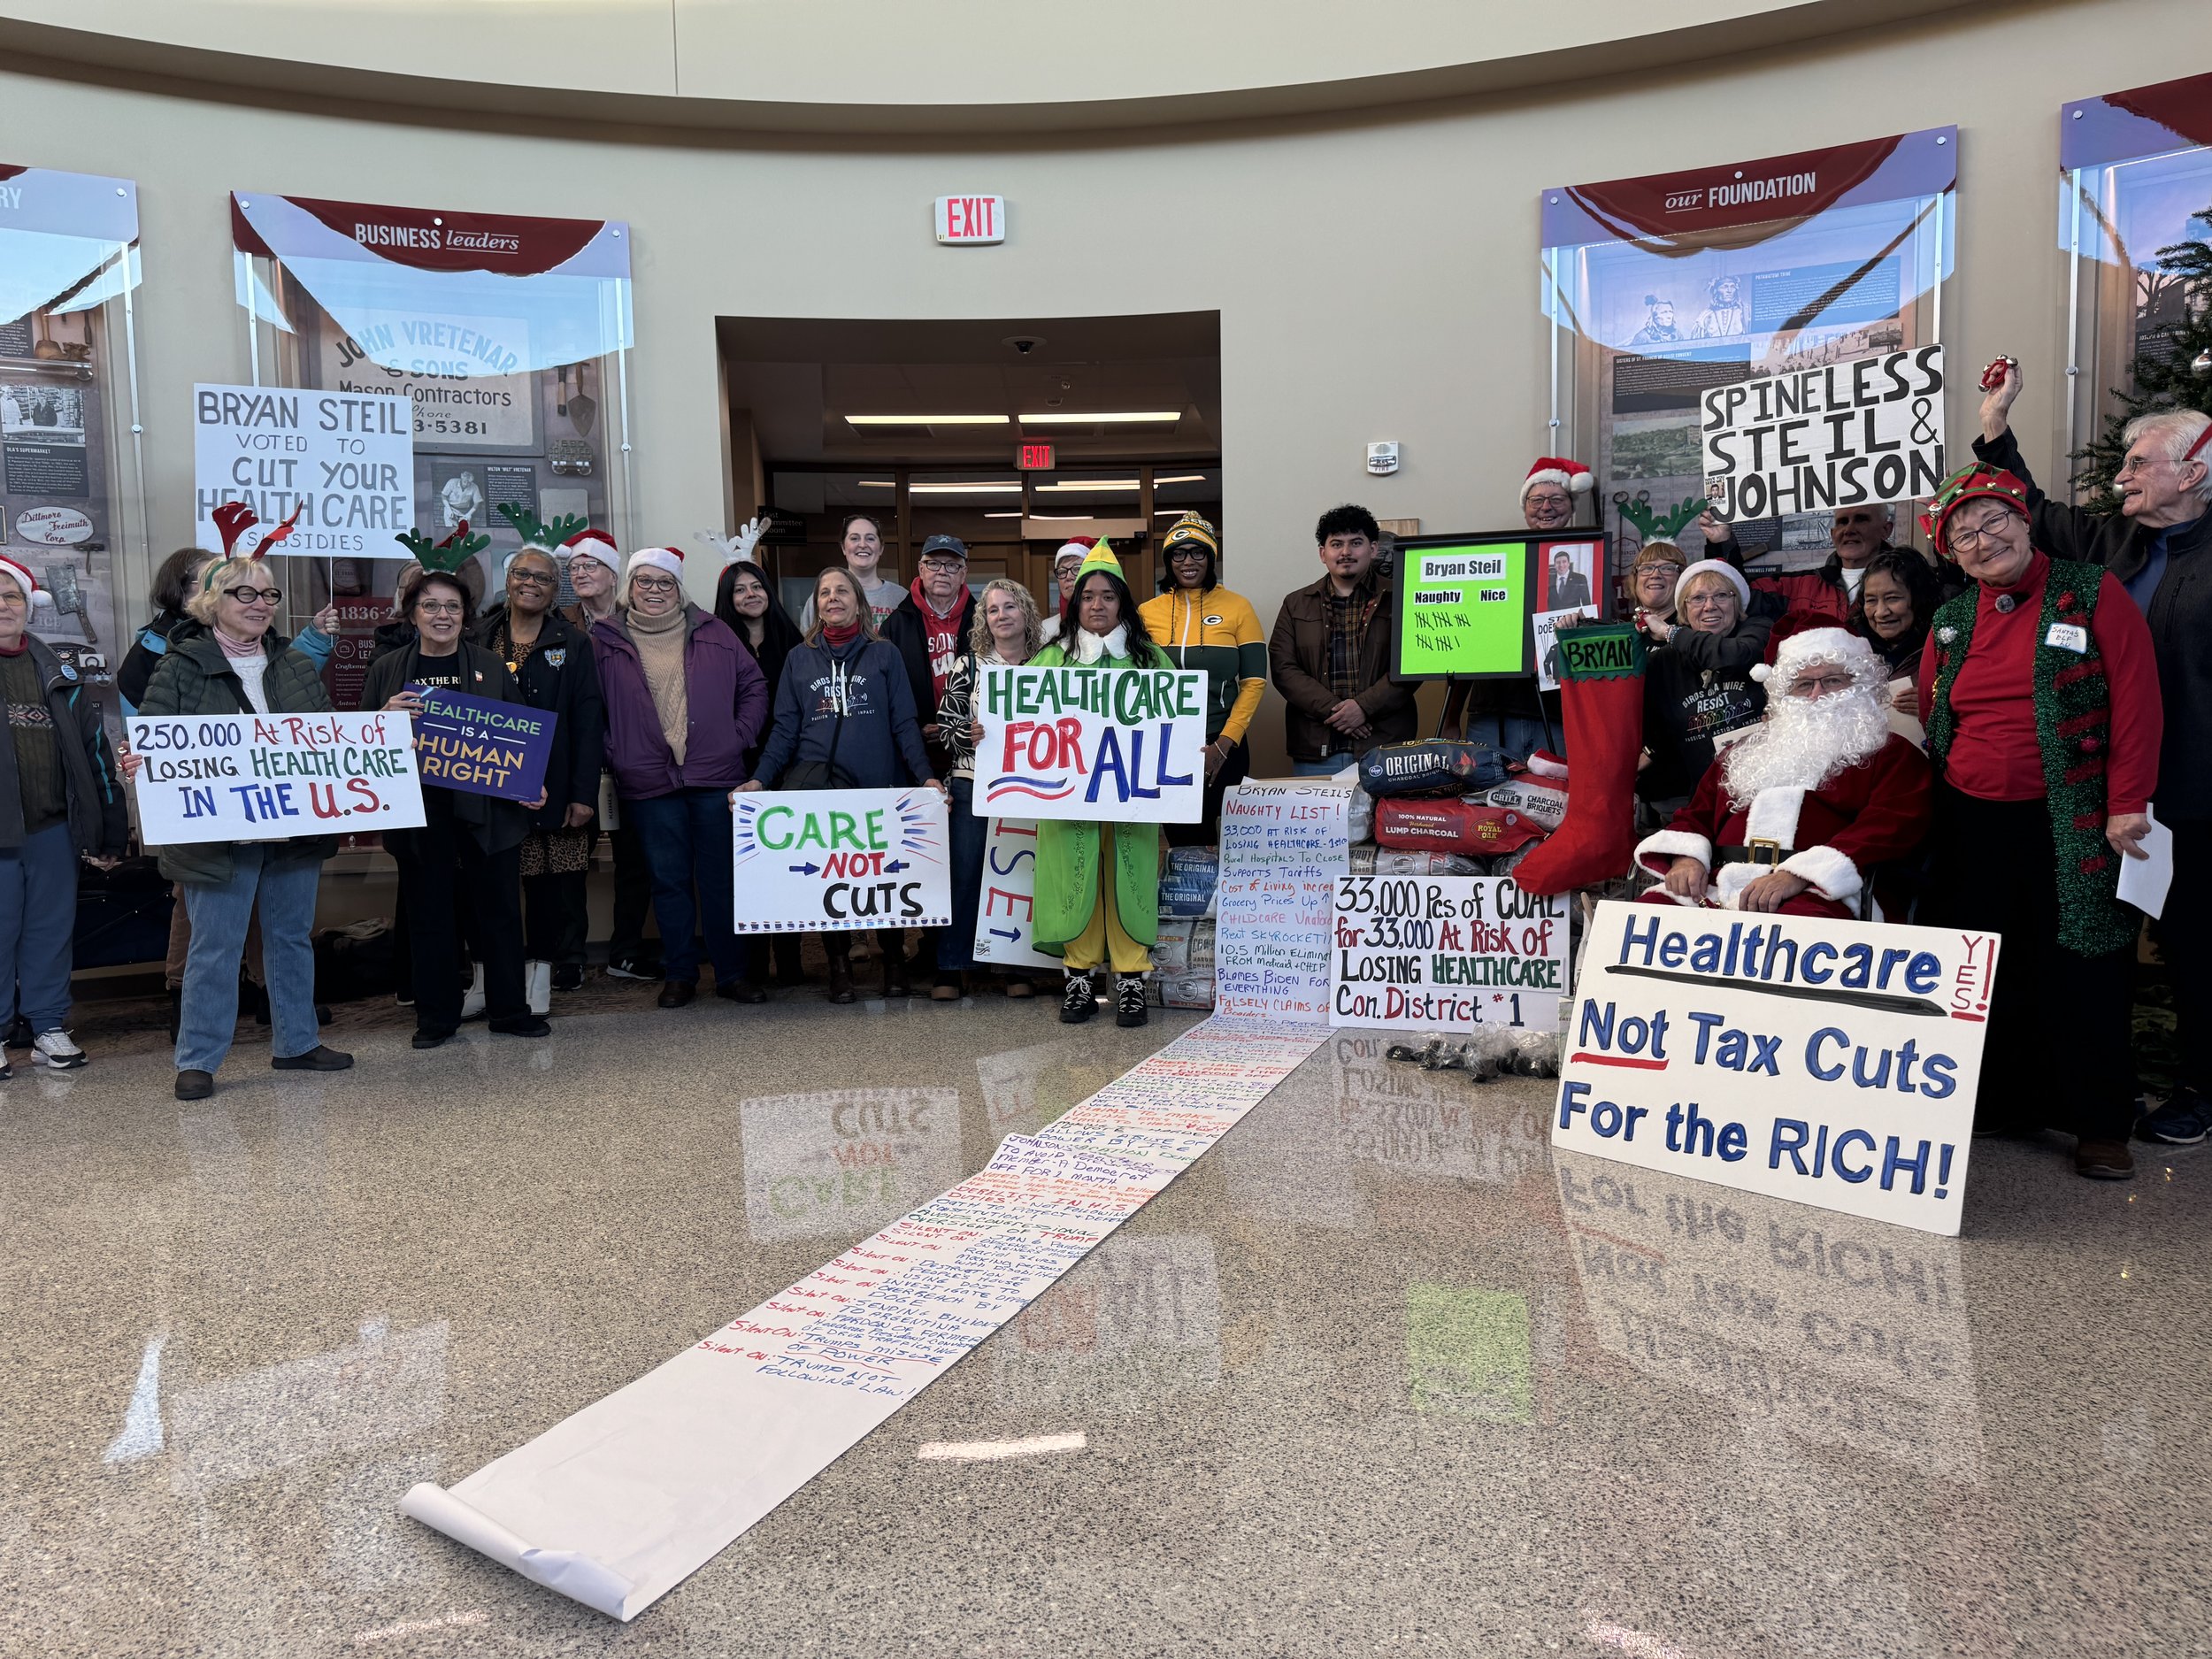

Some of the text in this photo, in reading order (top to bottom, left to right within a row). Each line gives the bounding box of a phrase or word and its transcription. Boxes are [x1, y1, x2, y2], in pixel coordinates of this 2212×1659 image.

[1665, 172, 1816, 209] our FOUNDATION
[947, 197, 995, 237] EXIT
[355, 223, 519, 250] BUSINESS leaders
[335, 320, 518, 378] JOHN VRETENAR
[410, 359, 469, 380] SONS
[340, 380, 512, 407] Mason Contractors
[1703, 346, 1942, 432] SPINELESS
[198, 391, 407, 434] BRYAN STEIL
[236, 434, 365, 455] VOTED TO
[1708, 397, 1940, 476] STEIL &
[1023, 445, 1050, 468] EXIT
[232, 457, 399, 491] CUT YOUR
[1710, 445, 1944, 522] JOHNSON
[1425, 559, 1502, 577] Bryan Steil
[1415, 589, 1506, 603] Naughty Nice
[340, 606, 396, 620] 1836-2
[1567, 636, 1632, 669] BRYAN
[428, 676, 449, 686] THE
[810, 676, 831, 692] BIRDS
[1723, 681, 1746, 691] WIRE
[1682, 690, 1705, 709] BIRDS
[1697, 692, 1730, 713] RESIST
[134, 714, 386, 751] 250,000 At Risk of
[461, 726, 489, 740] IS A
[1713, 726, 1735, 736] ACTION
[418, 733, 524, 771] HUMAN
[1002, 715, 1194, 803] FOR ALL
[144, 755, 240, 784] LOSING
[423, 756, 511, 788] RIGHT
[1386, 753, 1449, 776] ORIGINAL
[178, 778, 391, 823] IN THE U.S.
[1238, 785, 1353, 799] BRYAN STEIL'S
[1493, 794, 1520, 804] GRILL
[1527, 795, 1563, 810] CHARCOAL
[1225, 799, 1282, 820] NAUGHTY
[1526, 803, 1562, 816] BRIQUETS
[757, 805, 888, 851] CARE
[1224, 825, 1262, 837] 33,000
[1284, 826, 1307, 835] RISK
[1410, 828, 1459, 838] CHARCOAL
[1225, 840, 1259, 849] LOSING
[821, 850, 884, 879] NOT
[1171, 862, 1215, 874] THE ORIGINAL
[1316, 853, 1345, 863] CLOSE
[1279, 865, 1323, 878] Tariffs
[823, 881, 925, 919] CUTS
[1161, 892, 1206, 902] THE ORIGINAL
[1222, 894, 1318, 911] Grocery Prices Up
[1335, 877, 1564, 919] 33,000 Pcs of COAL
[1221, 927, 1246, 940] Rent
[1334, 916, 1365, 949] for
[1363, 917, 1433, 949] 33,000
[1438, 920, 1464, 951] At
[1471, 920, 1519, 956] Risk
[1220, 944, 1248, 956] 10.5
[1225, 956, 1253, 965] FROM
[1620, 914, 1942, 994] Healthcare
[1217, 967, 1259, 982] BLAMES
[1340, 949, 1562, 989] LOSING HEALTHCARE
[1225, 983, 1289, 995] EVERYTHING
[1336, 985, 1381, 1019] Con.
[1384, 987, 1483, 1023] District
[1578, 999, 1957, 1100] Not Tax Cuts
[1559, 1081, 1955, 1199] For the RICH!
[804, 1333, 860, 1348] TRUMPS
[697, 1340, 744, 1355] Silent
[778, 1355, 845, 1375] TRUMP
[847, 1371, 902, 1384] NOT
[819, 1347, 898, 1366] POWER
[757, 1364, 856, 1386] FOLLOWING
